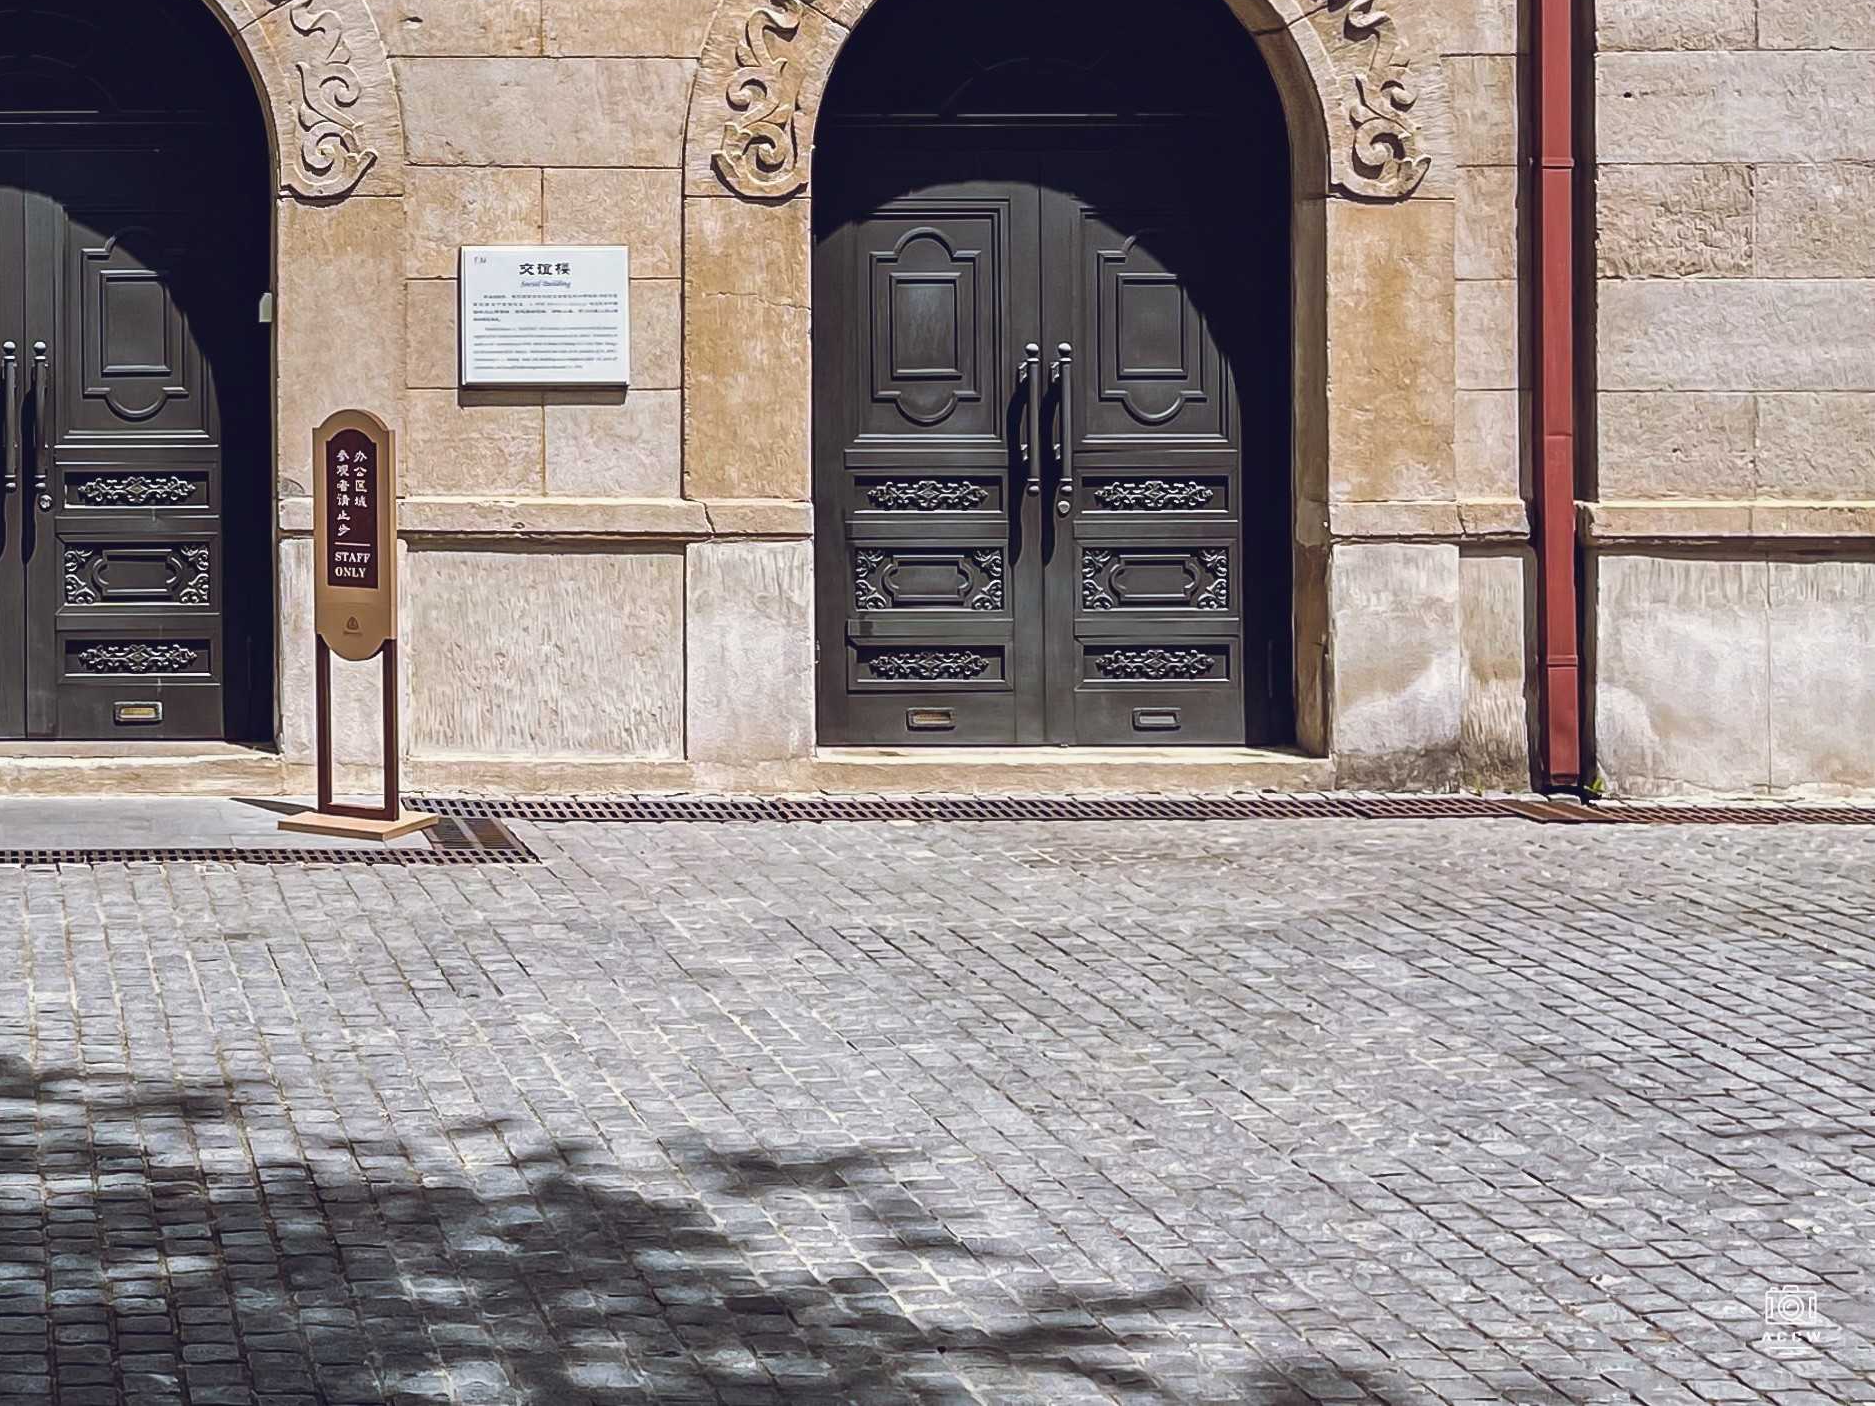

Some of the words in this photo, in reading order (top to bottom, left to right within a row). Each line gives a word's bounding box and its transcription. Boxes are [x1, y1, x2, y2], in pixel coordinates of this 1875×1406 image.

[518, 262, 571, 276] 交谊楼
[353, 450, 368, 508] 办公区域
[336, 449, 351, 537] 参观者请止步
[334, 551, 371, 563] STAFF
[335, 566, 367, 578] ONLY
